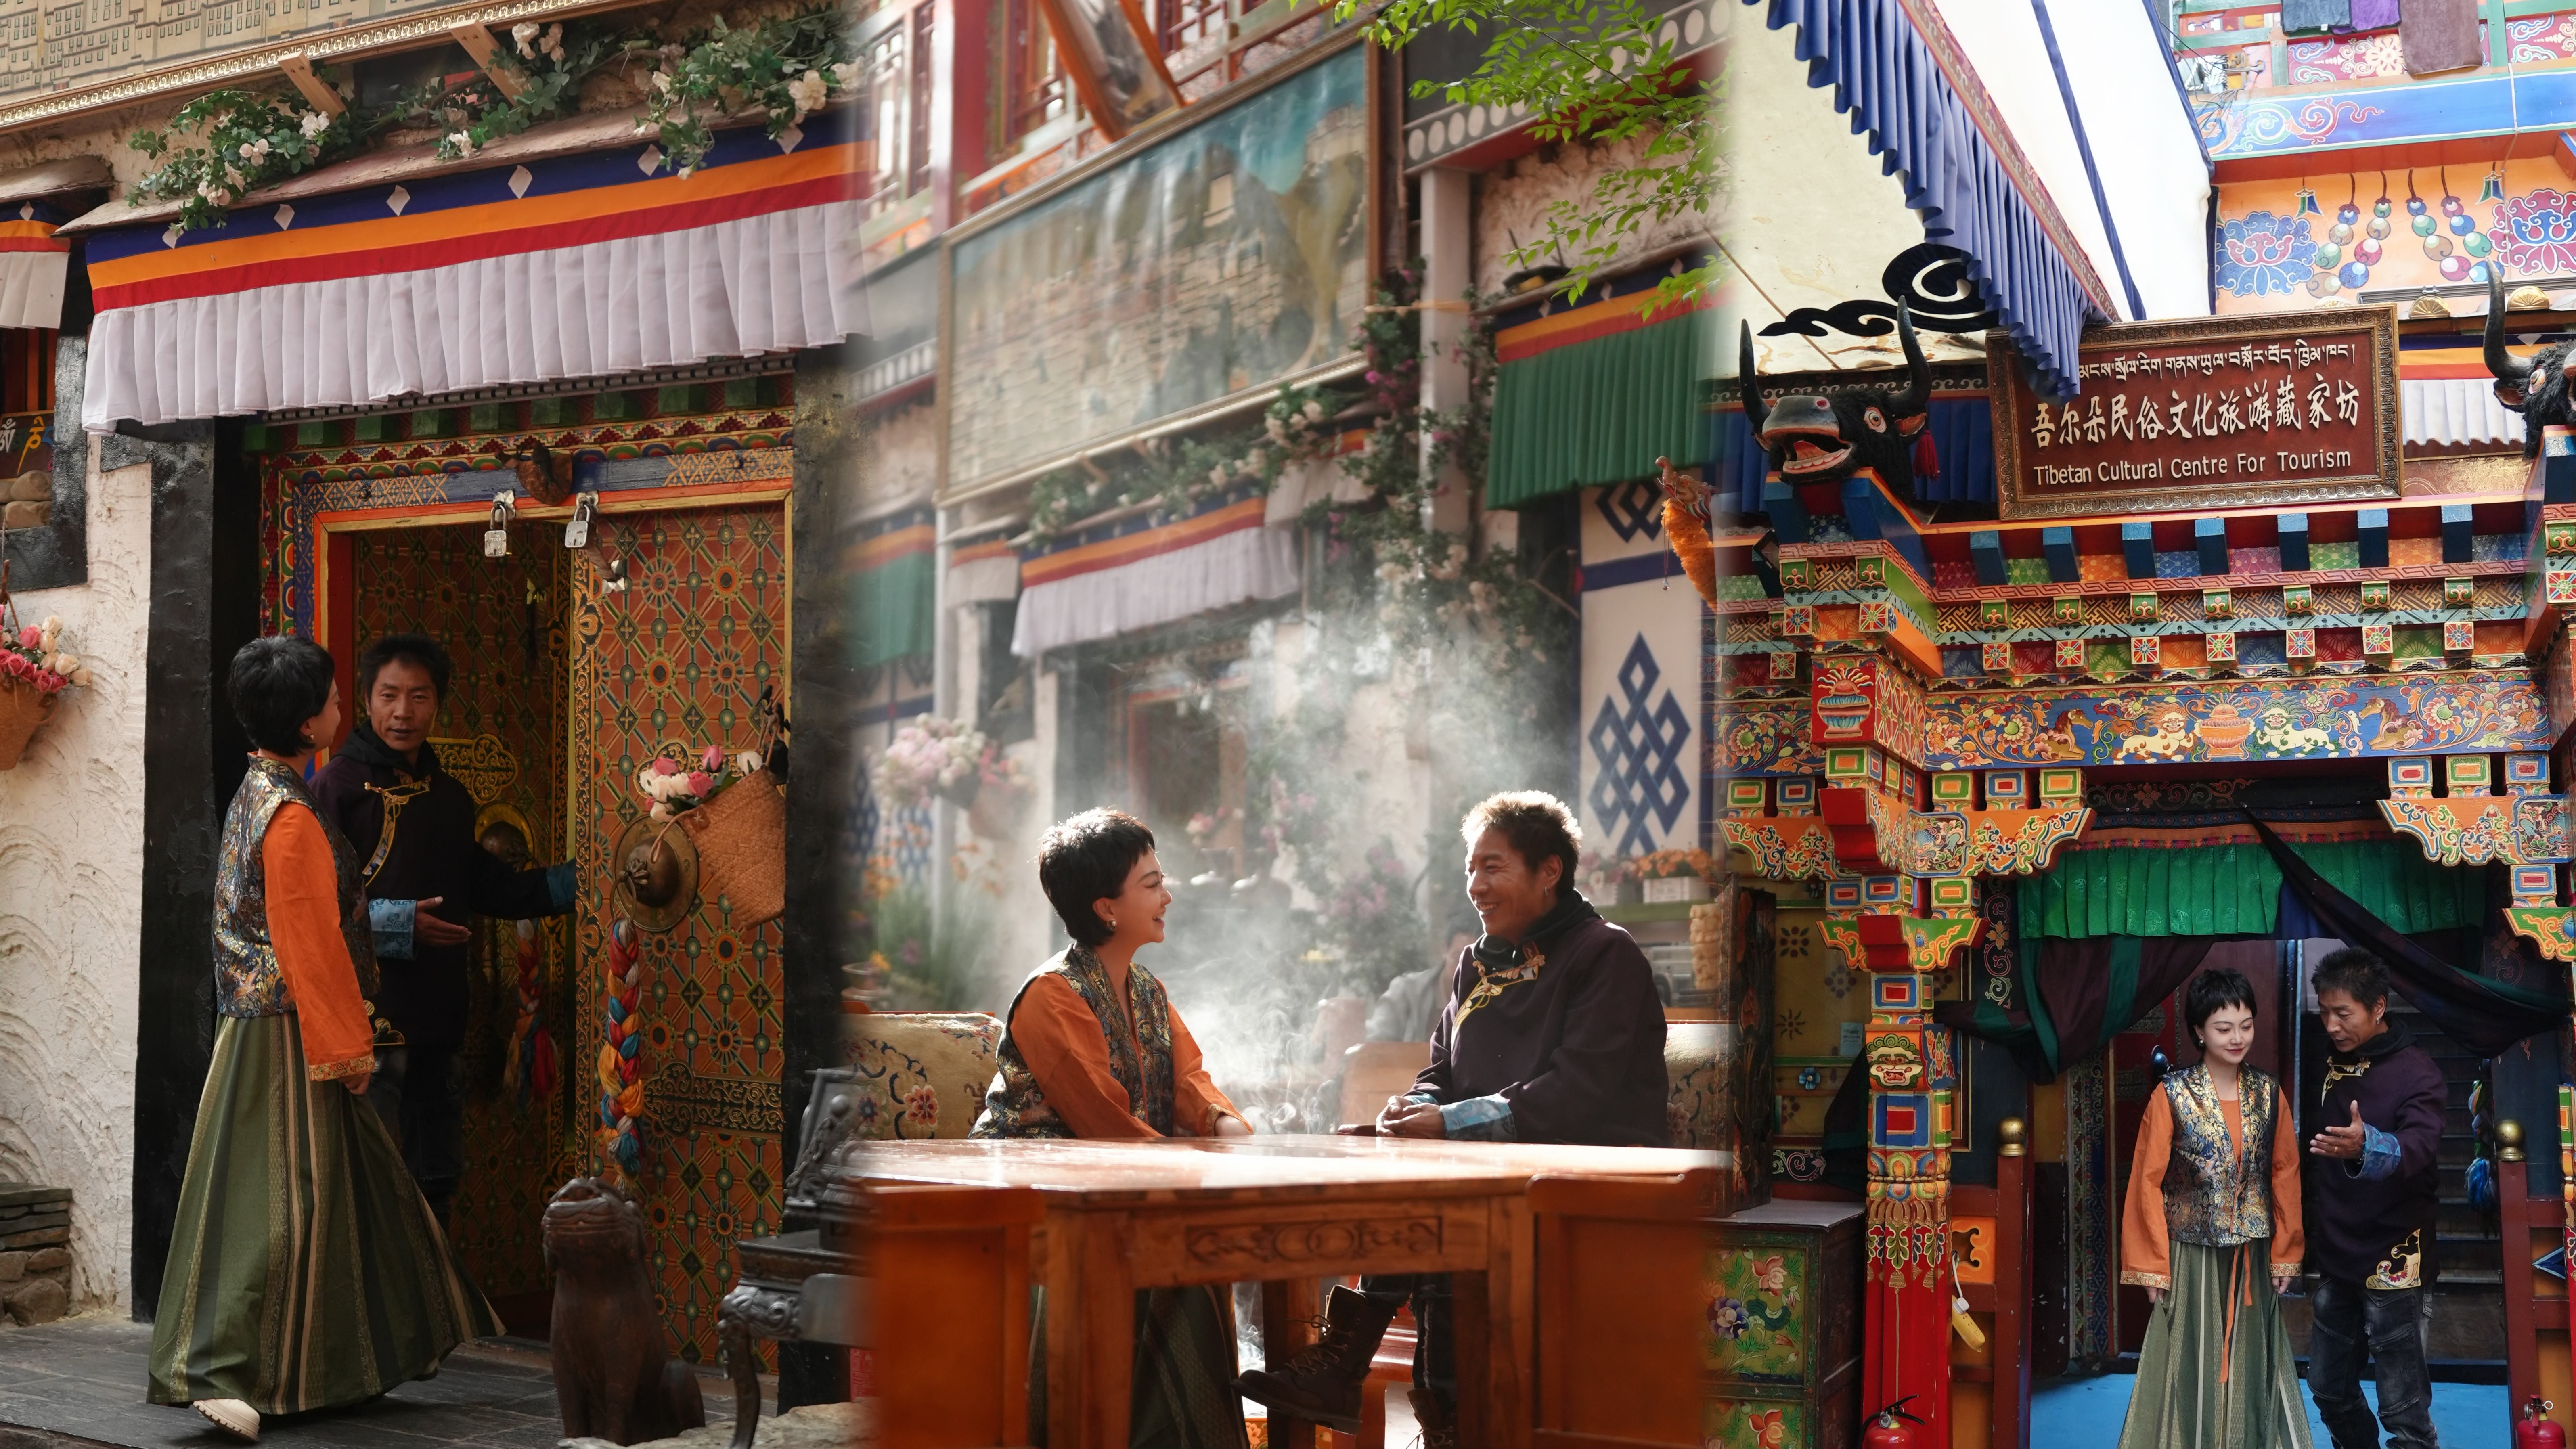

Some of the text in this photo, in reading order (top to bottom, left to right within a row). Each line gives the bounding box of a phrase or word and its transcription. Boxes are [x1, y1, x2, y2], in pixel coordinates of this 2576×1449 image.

[2031, 372, 2360, 448] 吾尔朵民俗文化旅游藏家坊
[2033, 449, 2351, 485] Tibetan Cultural Centre For Tourism
